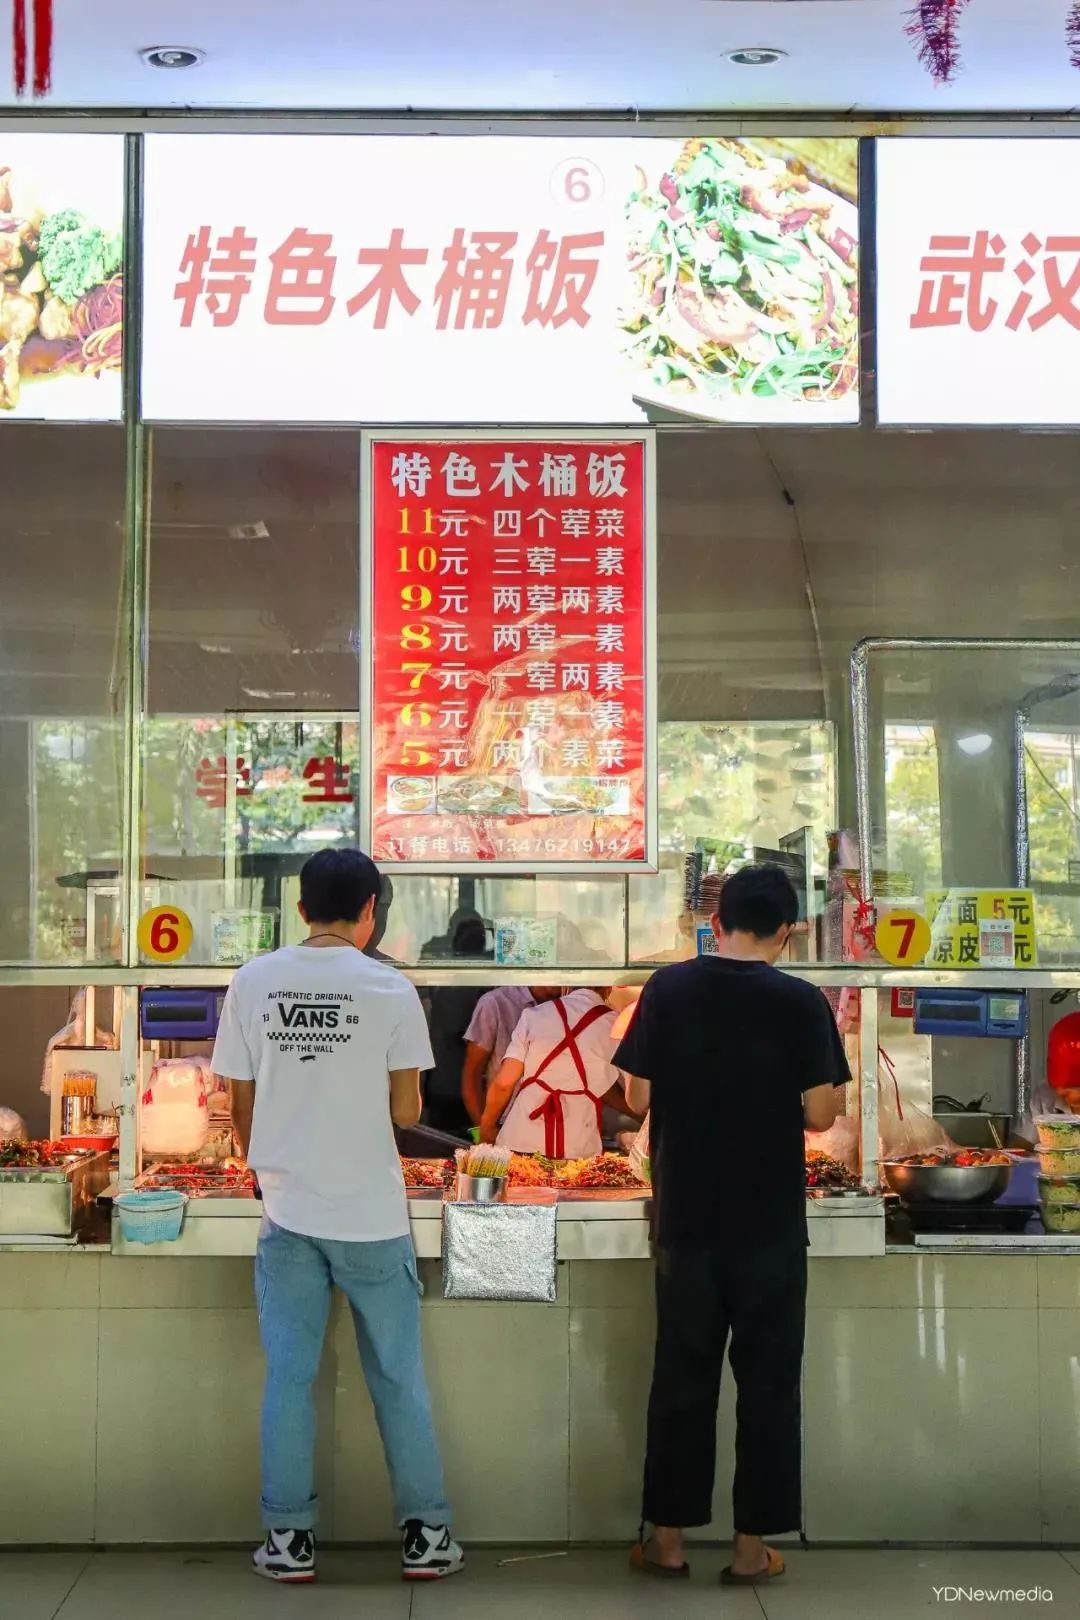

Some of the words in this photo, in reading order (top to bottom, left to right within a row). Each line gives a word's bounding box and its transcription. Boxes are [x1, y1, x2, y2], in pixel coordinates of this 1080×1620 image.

[564, 167, 591, 203] 6
[172, 225, 606, 331] 特色木桶饭
[909, 230, 1080, 333] 武汉
[391, 452, 629, 498] 特色木桶饭
[397, 507, 469, 538] 11元
[492, 507, 625, 538] 四个荤菜
[397, 546, 469, 576] 10元
[492, 546, 625, 576] 三荤一素
[400, 584, 469, 614] 9元
[492, 584, 625, 614] 两荤两素
[400, 623, 469, 653] 8元
[492, 623, 625, 653] 两荤一素
[400, 661, 469, 691] 7元
[492, 661, 625, 691] 一荤两素
[400, 700, 469, 730] 6元
[400, 739, 469, 769] 5元
[151, 914, 179, 954] 6
[890, 918, 916, 959] 7
[268, 991, 312, 1000] AUTHENTIC
[314, 993, 354, 1002] ORIGINAL
[278, 1002, 341, 1028] VANS
[346, 1015, 359, 1024] 66
[279, 1044, 294, 1052] OFF
[296, 1044, 312, 1052] THE
[313, 1045, 334, 1053] WALL
